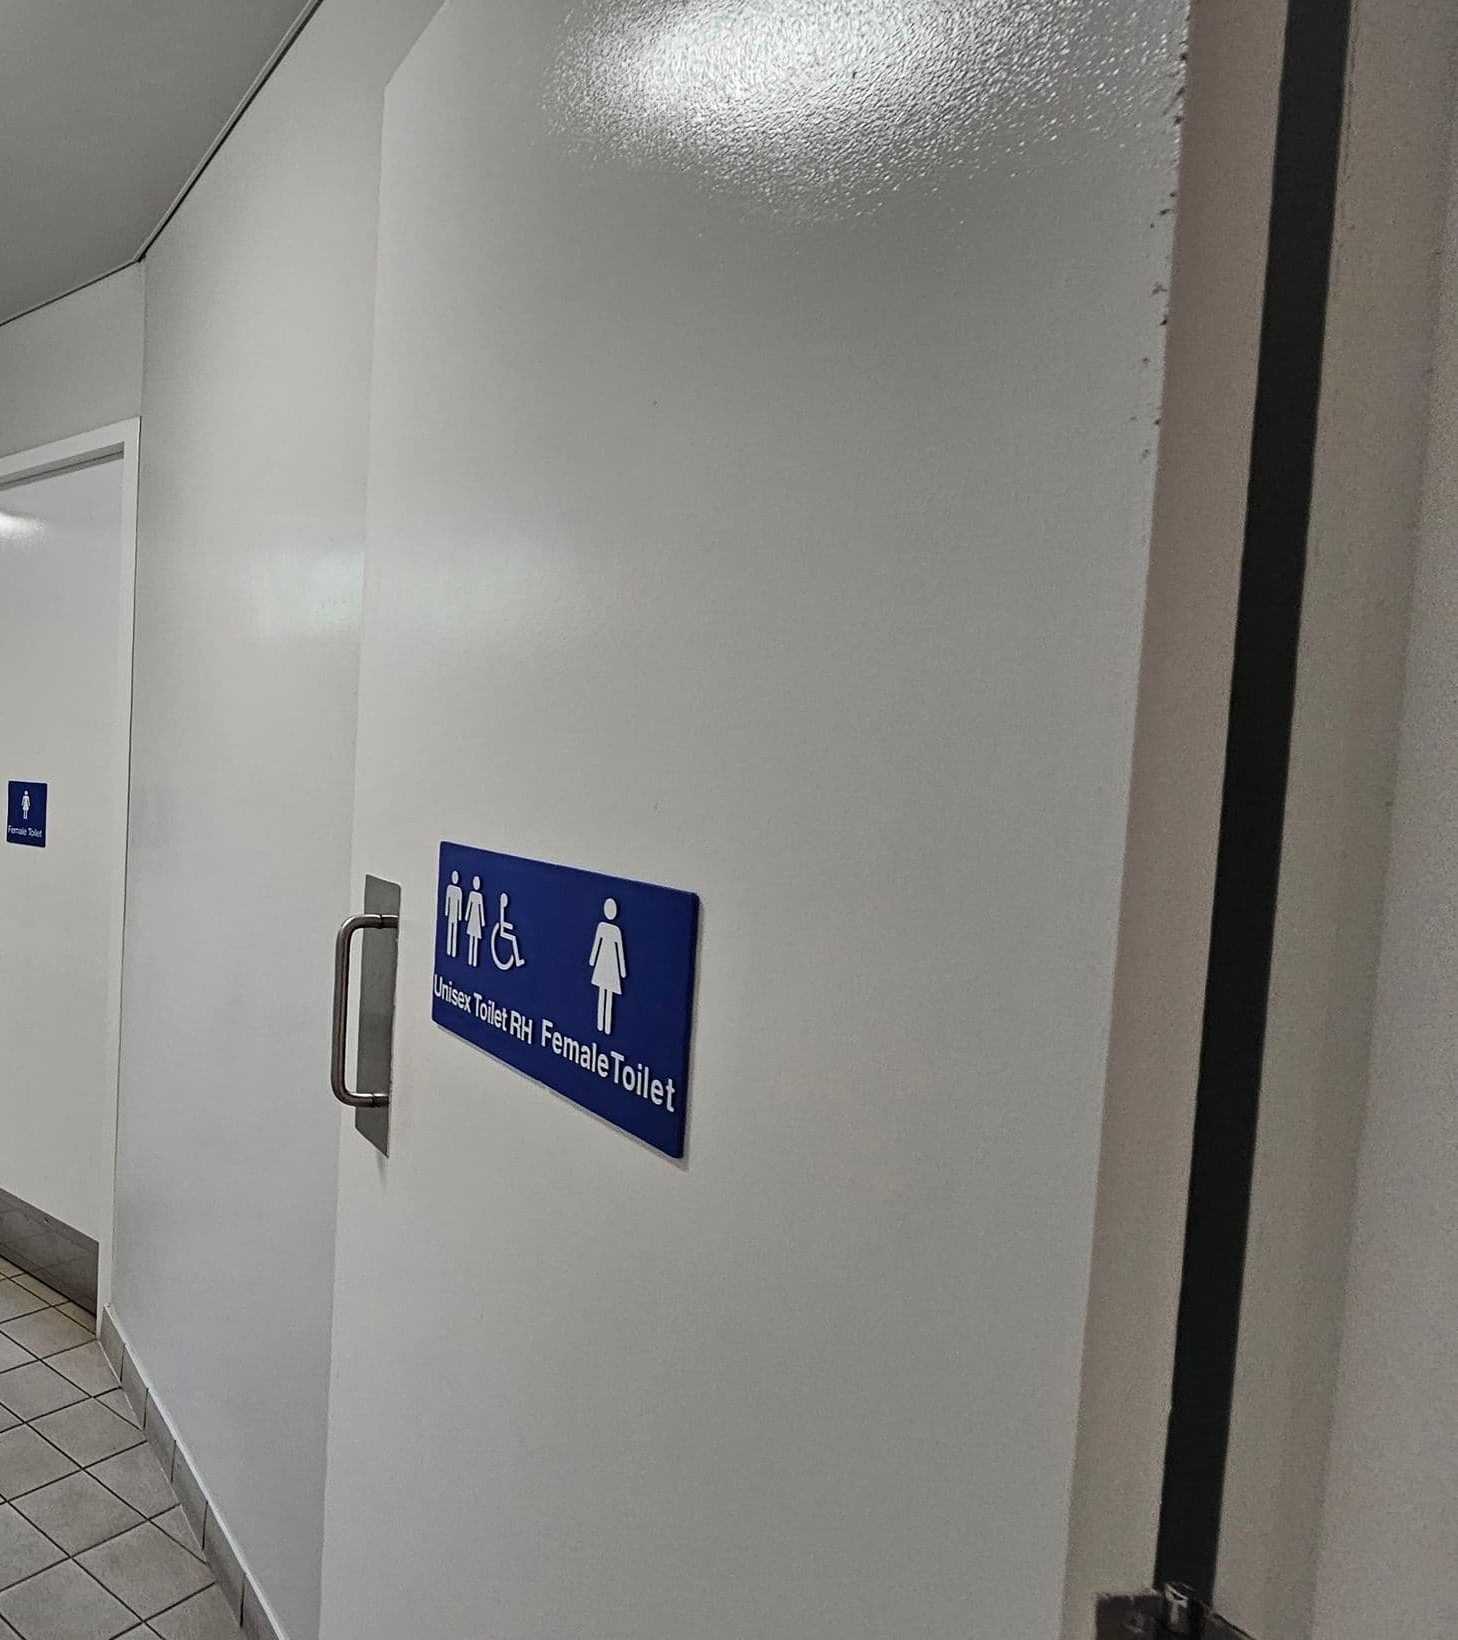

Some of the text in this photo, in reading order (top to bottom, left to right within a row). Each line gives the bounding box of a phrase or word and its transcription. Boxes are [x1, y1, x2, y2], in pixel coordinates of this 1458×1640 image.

[434, 974, 533, 1044] Unisex Toilet RH
[541, 1018, 675, 1112] Female Toilet
